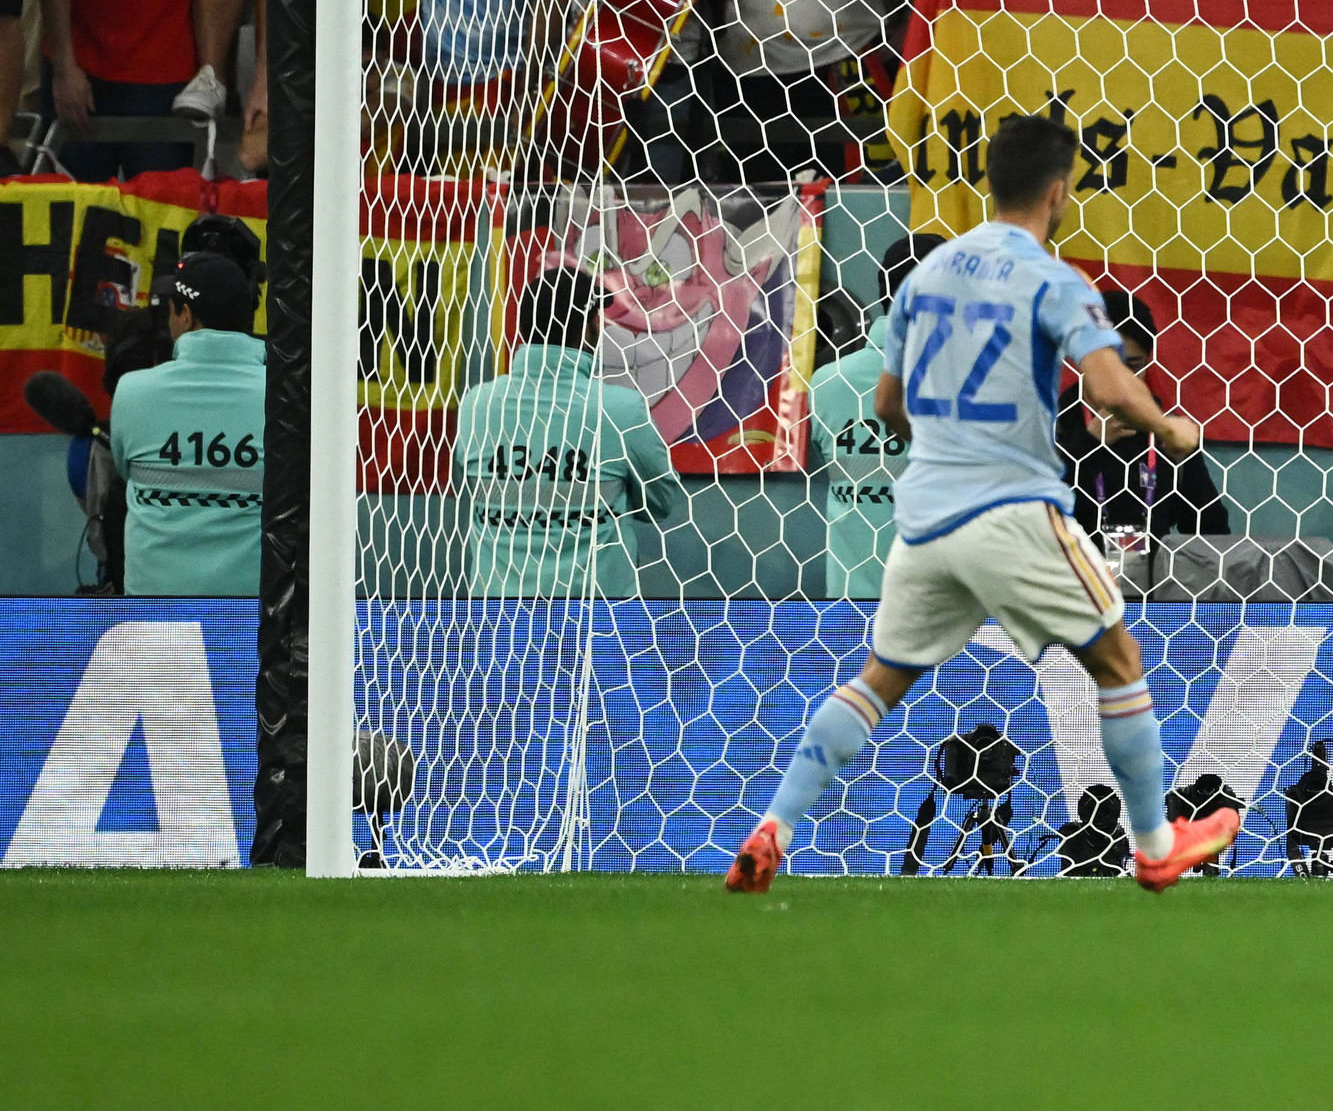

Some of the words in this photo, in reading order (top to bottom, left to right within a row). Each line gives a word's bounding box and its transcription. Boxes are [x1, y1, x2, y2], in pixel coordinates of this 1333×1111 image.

[907, 295, 1018, 422] 22
[159, 432, 259, 468] 4166
[488, 445, 589, 482] 4348
